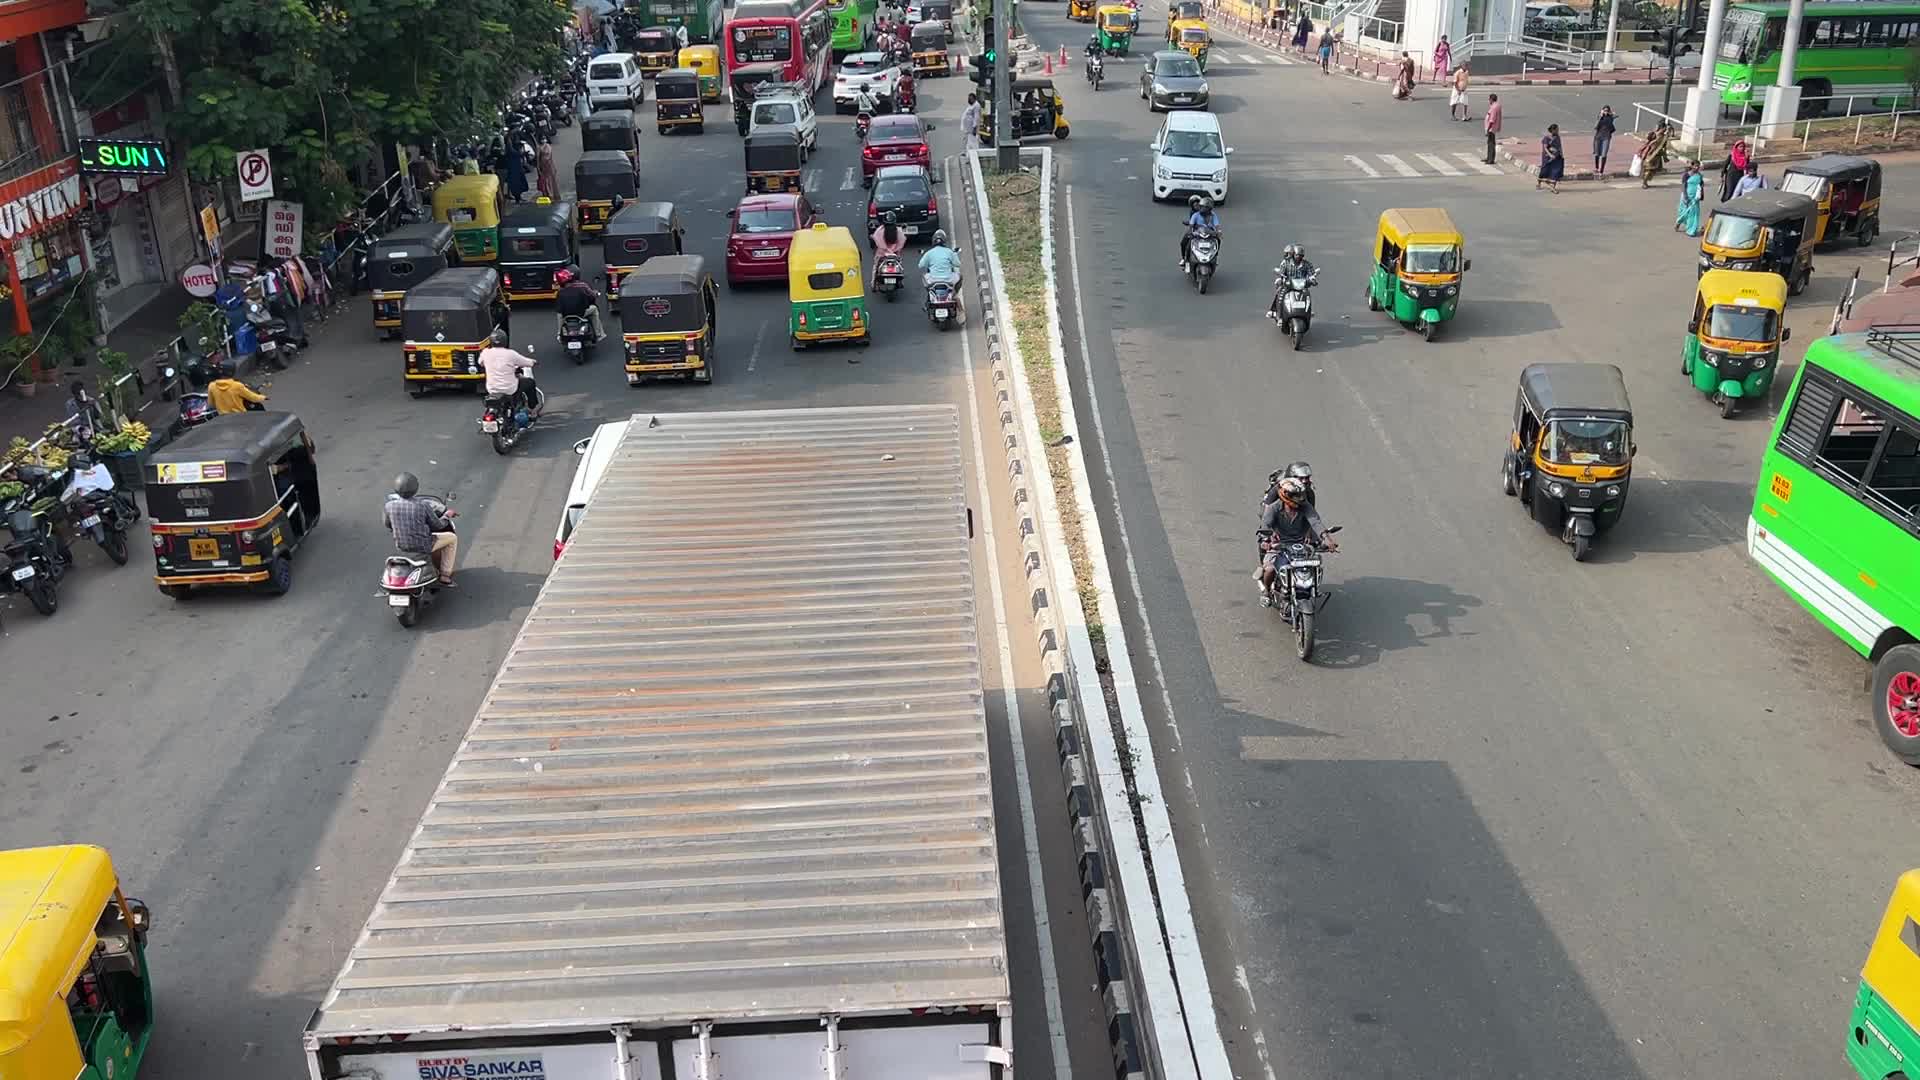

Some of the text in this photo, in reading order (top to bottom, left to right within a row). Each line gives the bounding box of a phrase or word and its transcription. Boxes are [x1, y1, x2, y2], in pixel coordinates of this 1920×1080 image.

[98, 145, 149, 167] SUN
[419, 1060, 544, 1080] SIVA SANKAR
